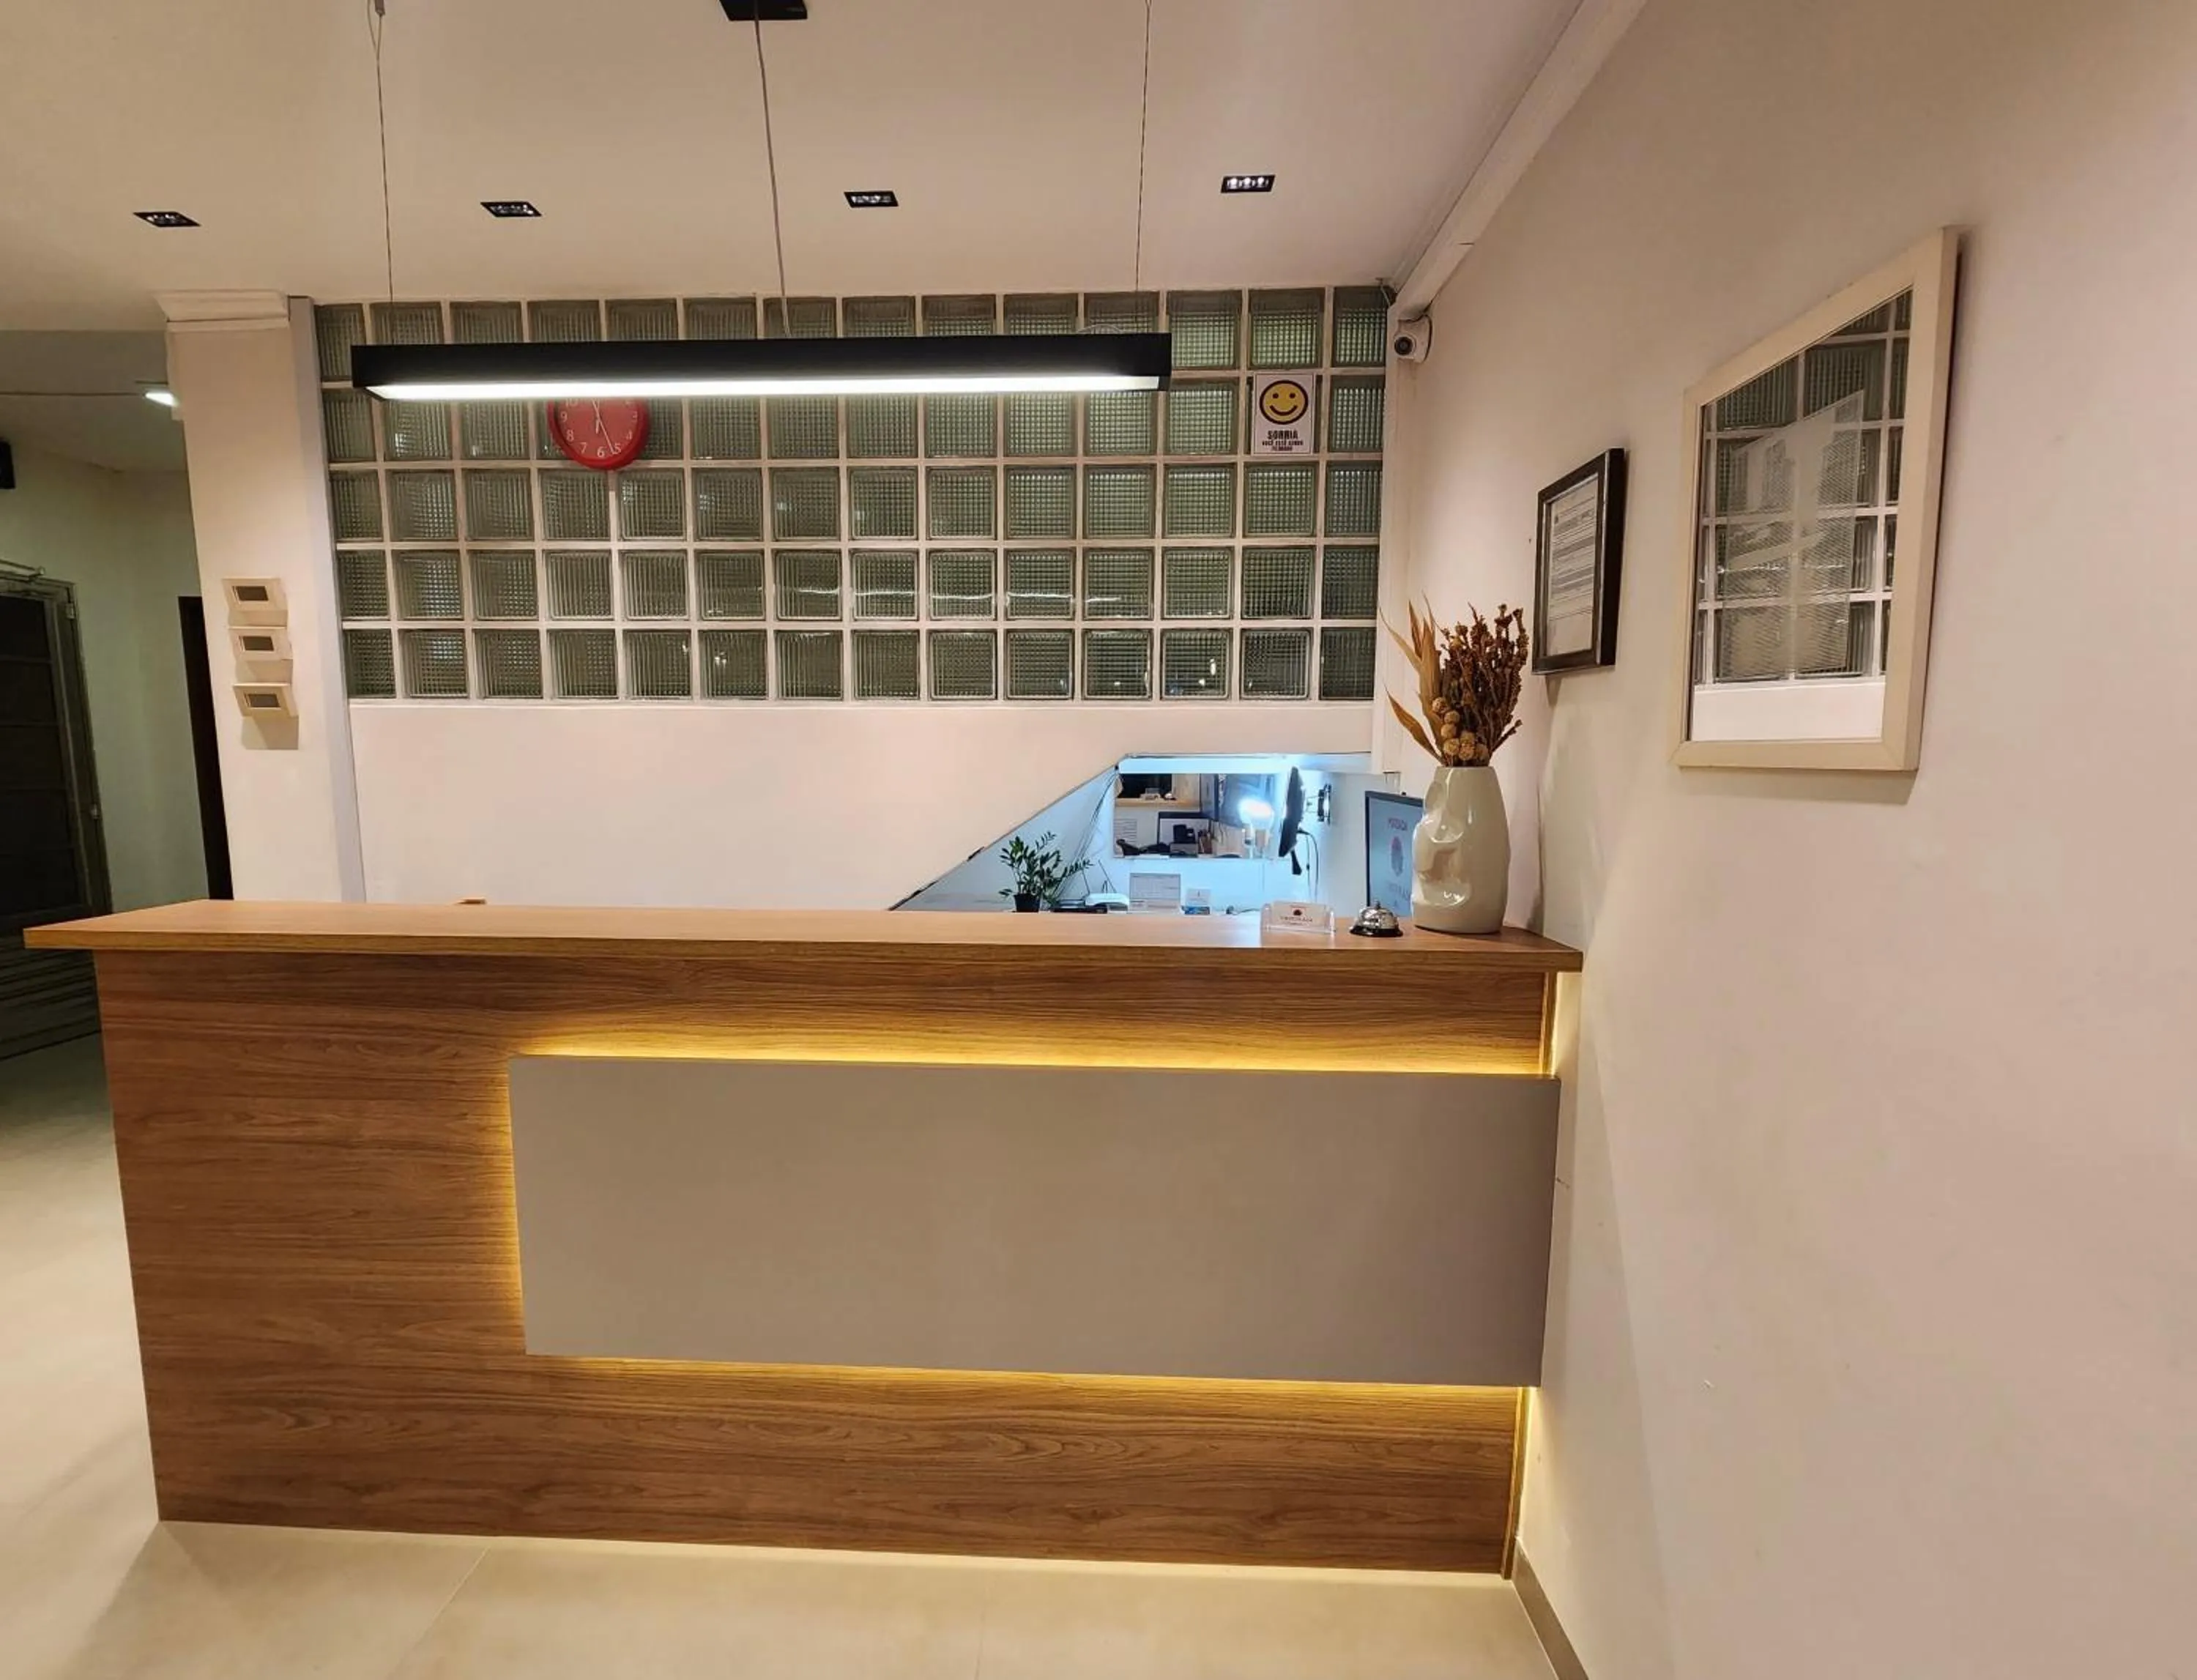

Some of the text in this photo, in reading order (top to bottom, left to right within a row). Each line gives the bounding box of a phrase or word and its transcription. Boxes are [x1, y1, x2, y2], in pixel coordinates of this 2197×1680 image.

[560, 411, 568, 423] 9
[632, 411, 638, 423] 3
[566, 429, 575, 442] 8
[625, 430, 633, 440] 4
[1267, 430, 1298, 439] SORRIA
[580, 442, 587, 454] 7
[597, 447, 606, 458] 6
[614, 442, 622, 454] 5
